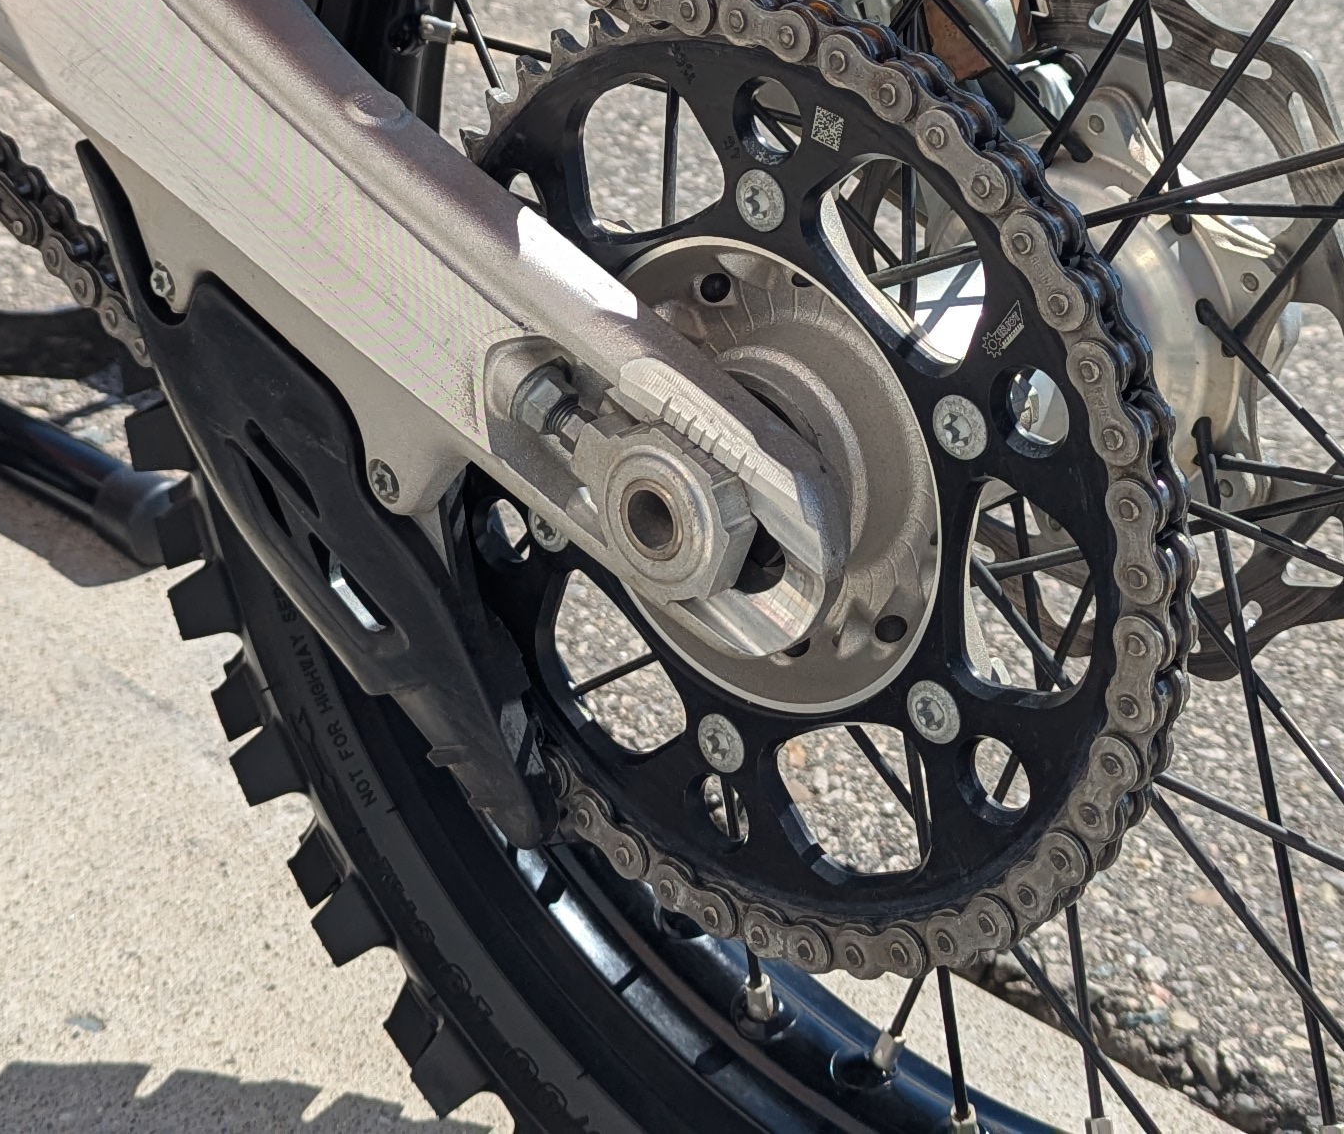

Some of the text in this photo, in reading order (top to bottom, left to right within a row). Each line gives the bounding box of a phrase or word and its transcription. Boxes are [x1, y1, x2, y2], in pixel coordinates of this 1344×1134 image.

[289, 633, 335, 715] HIGHWAY
[327, 718, 355, 762] FOR
[348, 768, 378, 809] NOT
